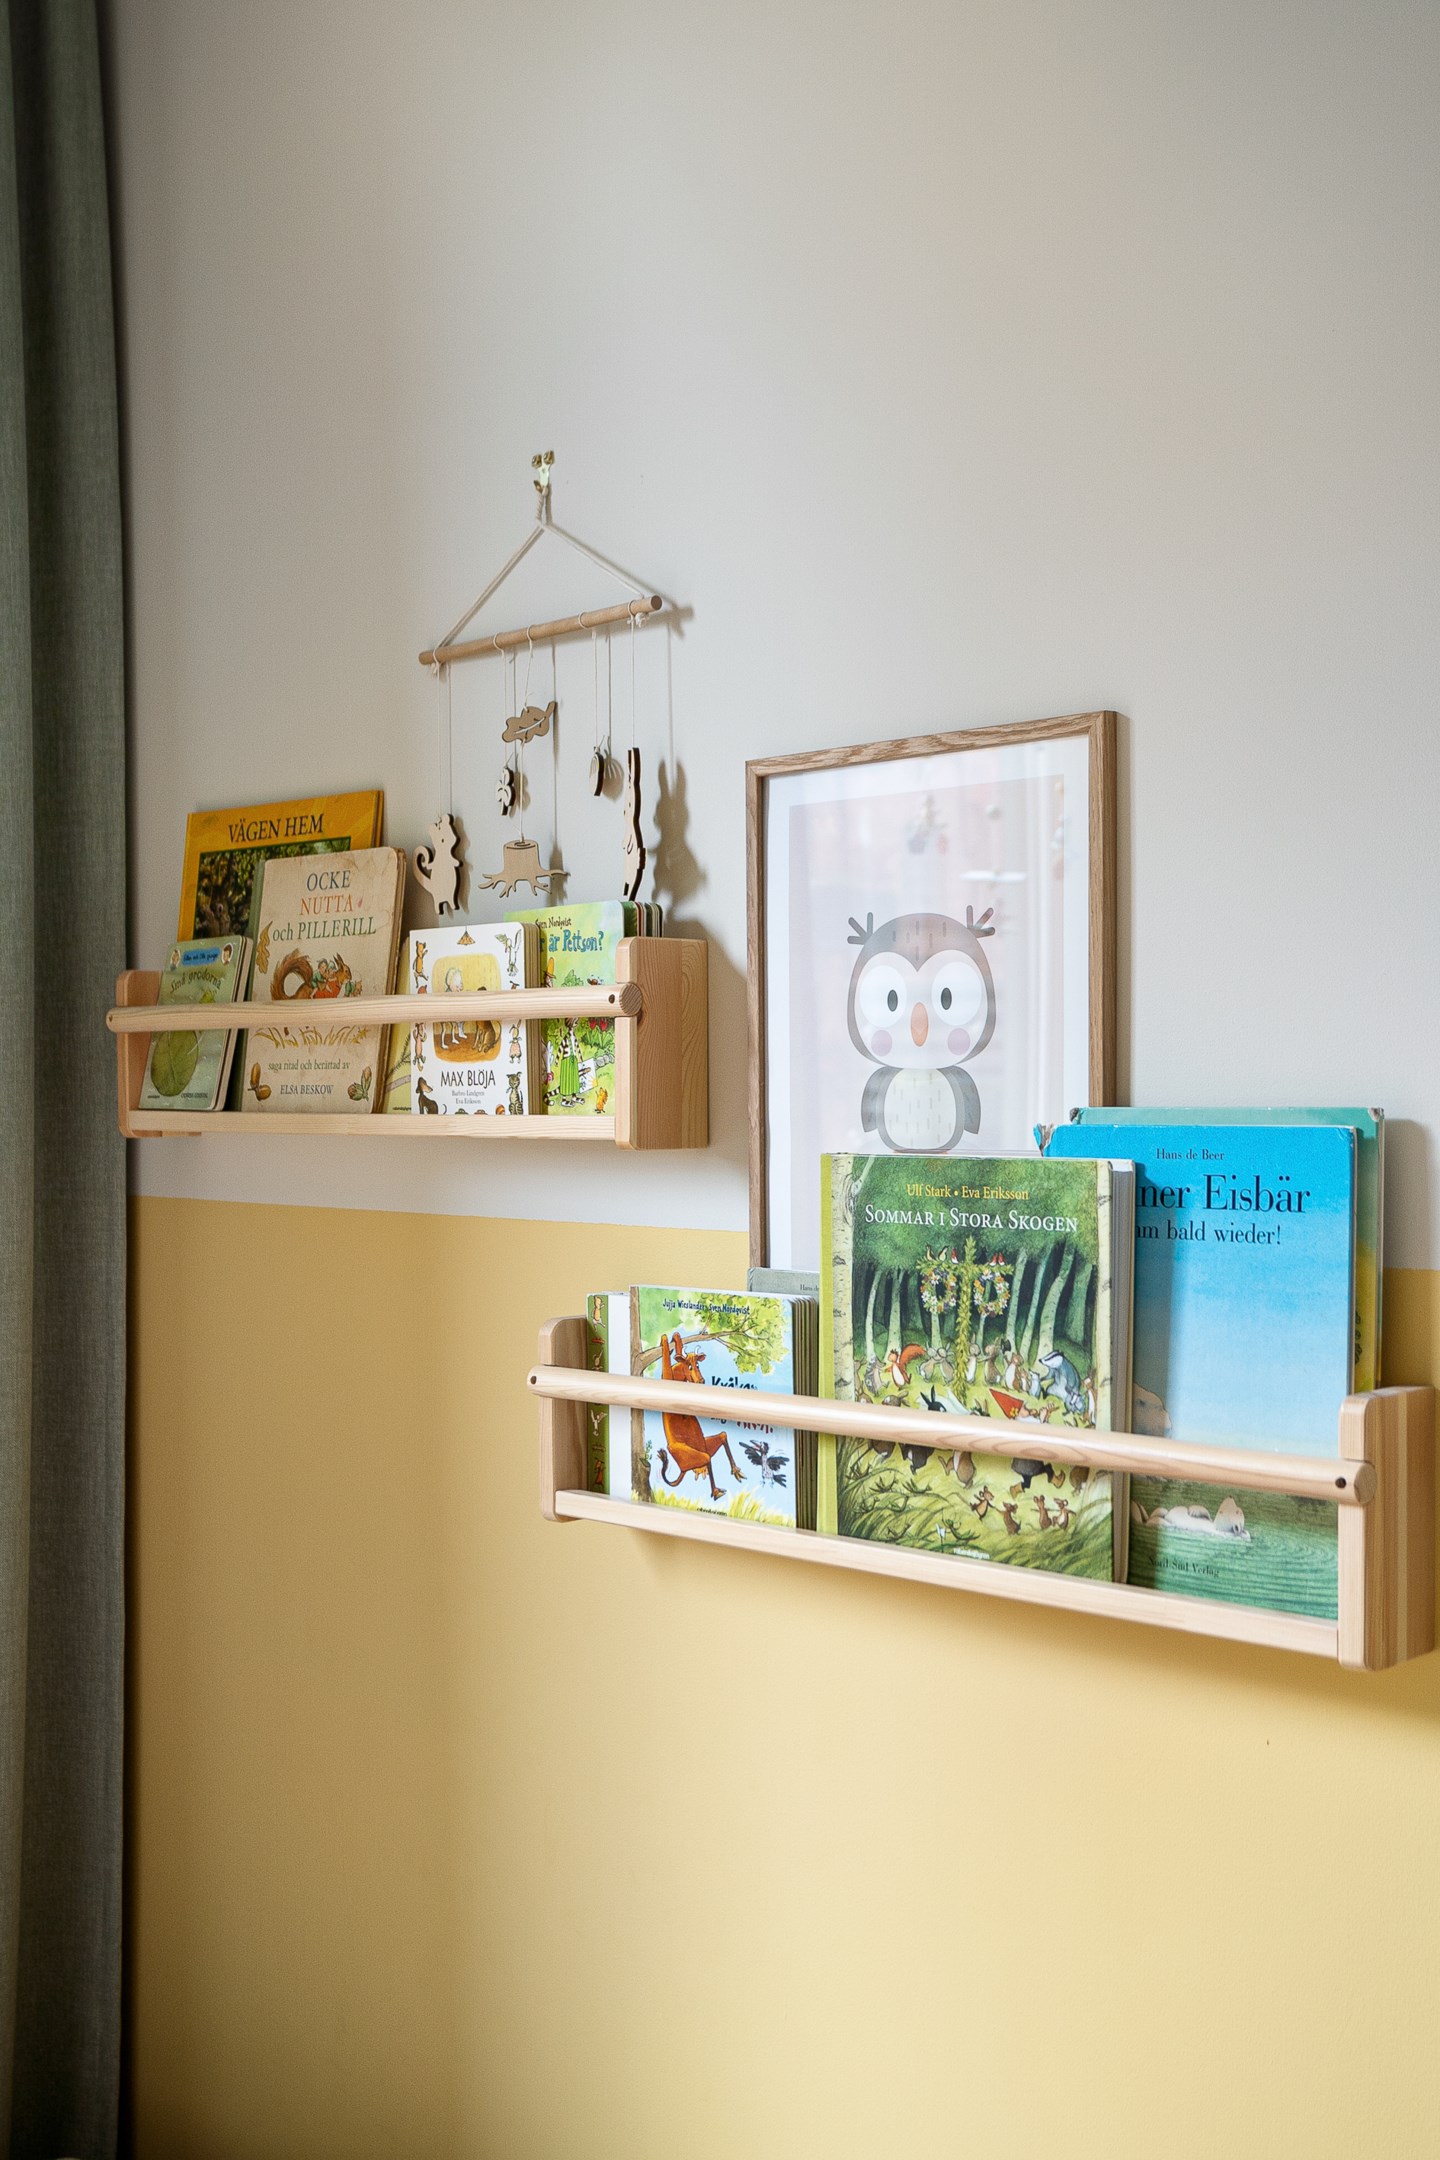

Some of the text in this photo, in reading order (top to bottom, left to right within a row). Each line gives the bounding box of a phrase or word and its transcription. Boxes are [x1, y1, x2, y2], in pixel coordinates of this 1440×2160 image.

[228, 813, 324, 843] VÄGEN HEM
[306, 869, 351, 891] OCKE
[300, 893, 353, 915] NUTTA
[272, 916, 377, 941] och PILLERILL
[548, 933, 560, 952] är
[562, 929, 604, 952] Pettson?
[300, 1059, 313, 1070] och
[280, 1084, 334, 1095] ELSA BESKOW
[440, 1069, 496, 1089] MAX BLÖJA
[1156, 1148, 1224, 1161] Hans de Beer
[906, 1184, 1029, 1200] Ulf Stark Eva Eriksson
[1202, 1174, 1311, 1213] Eisbär
[1167, 1219, 1206, 1241] bald
[1214, 1222, 1281, 1245] wieder!
